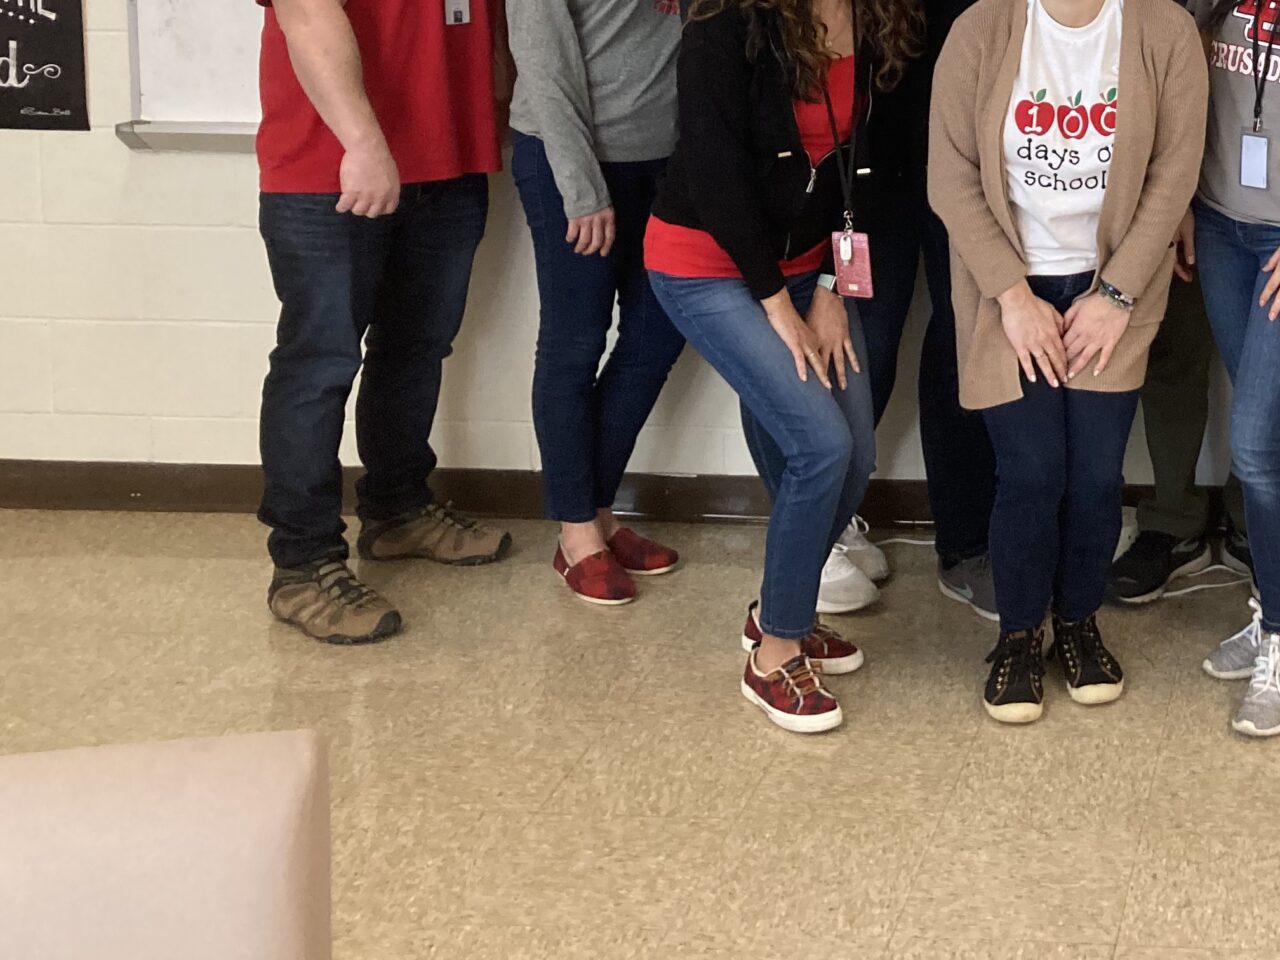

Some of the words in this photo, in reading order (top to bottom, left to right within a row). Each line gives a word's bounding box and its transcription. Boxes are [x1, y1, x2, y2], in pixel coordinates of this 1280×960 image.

[1017, 138, 1080, 170] days
[1098, 144, 1114, 162] o
[1024, 170, 1107, 191] school
